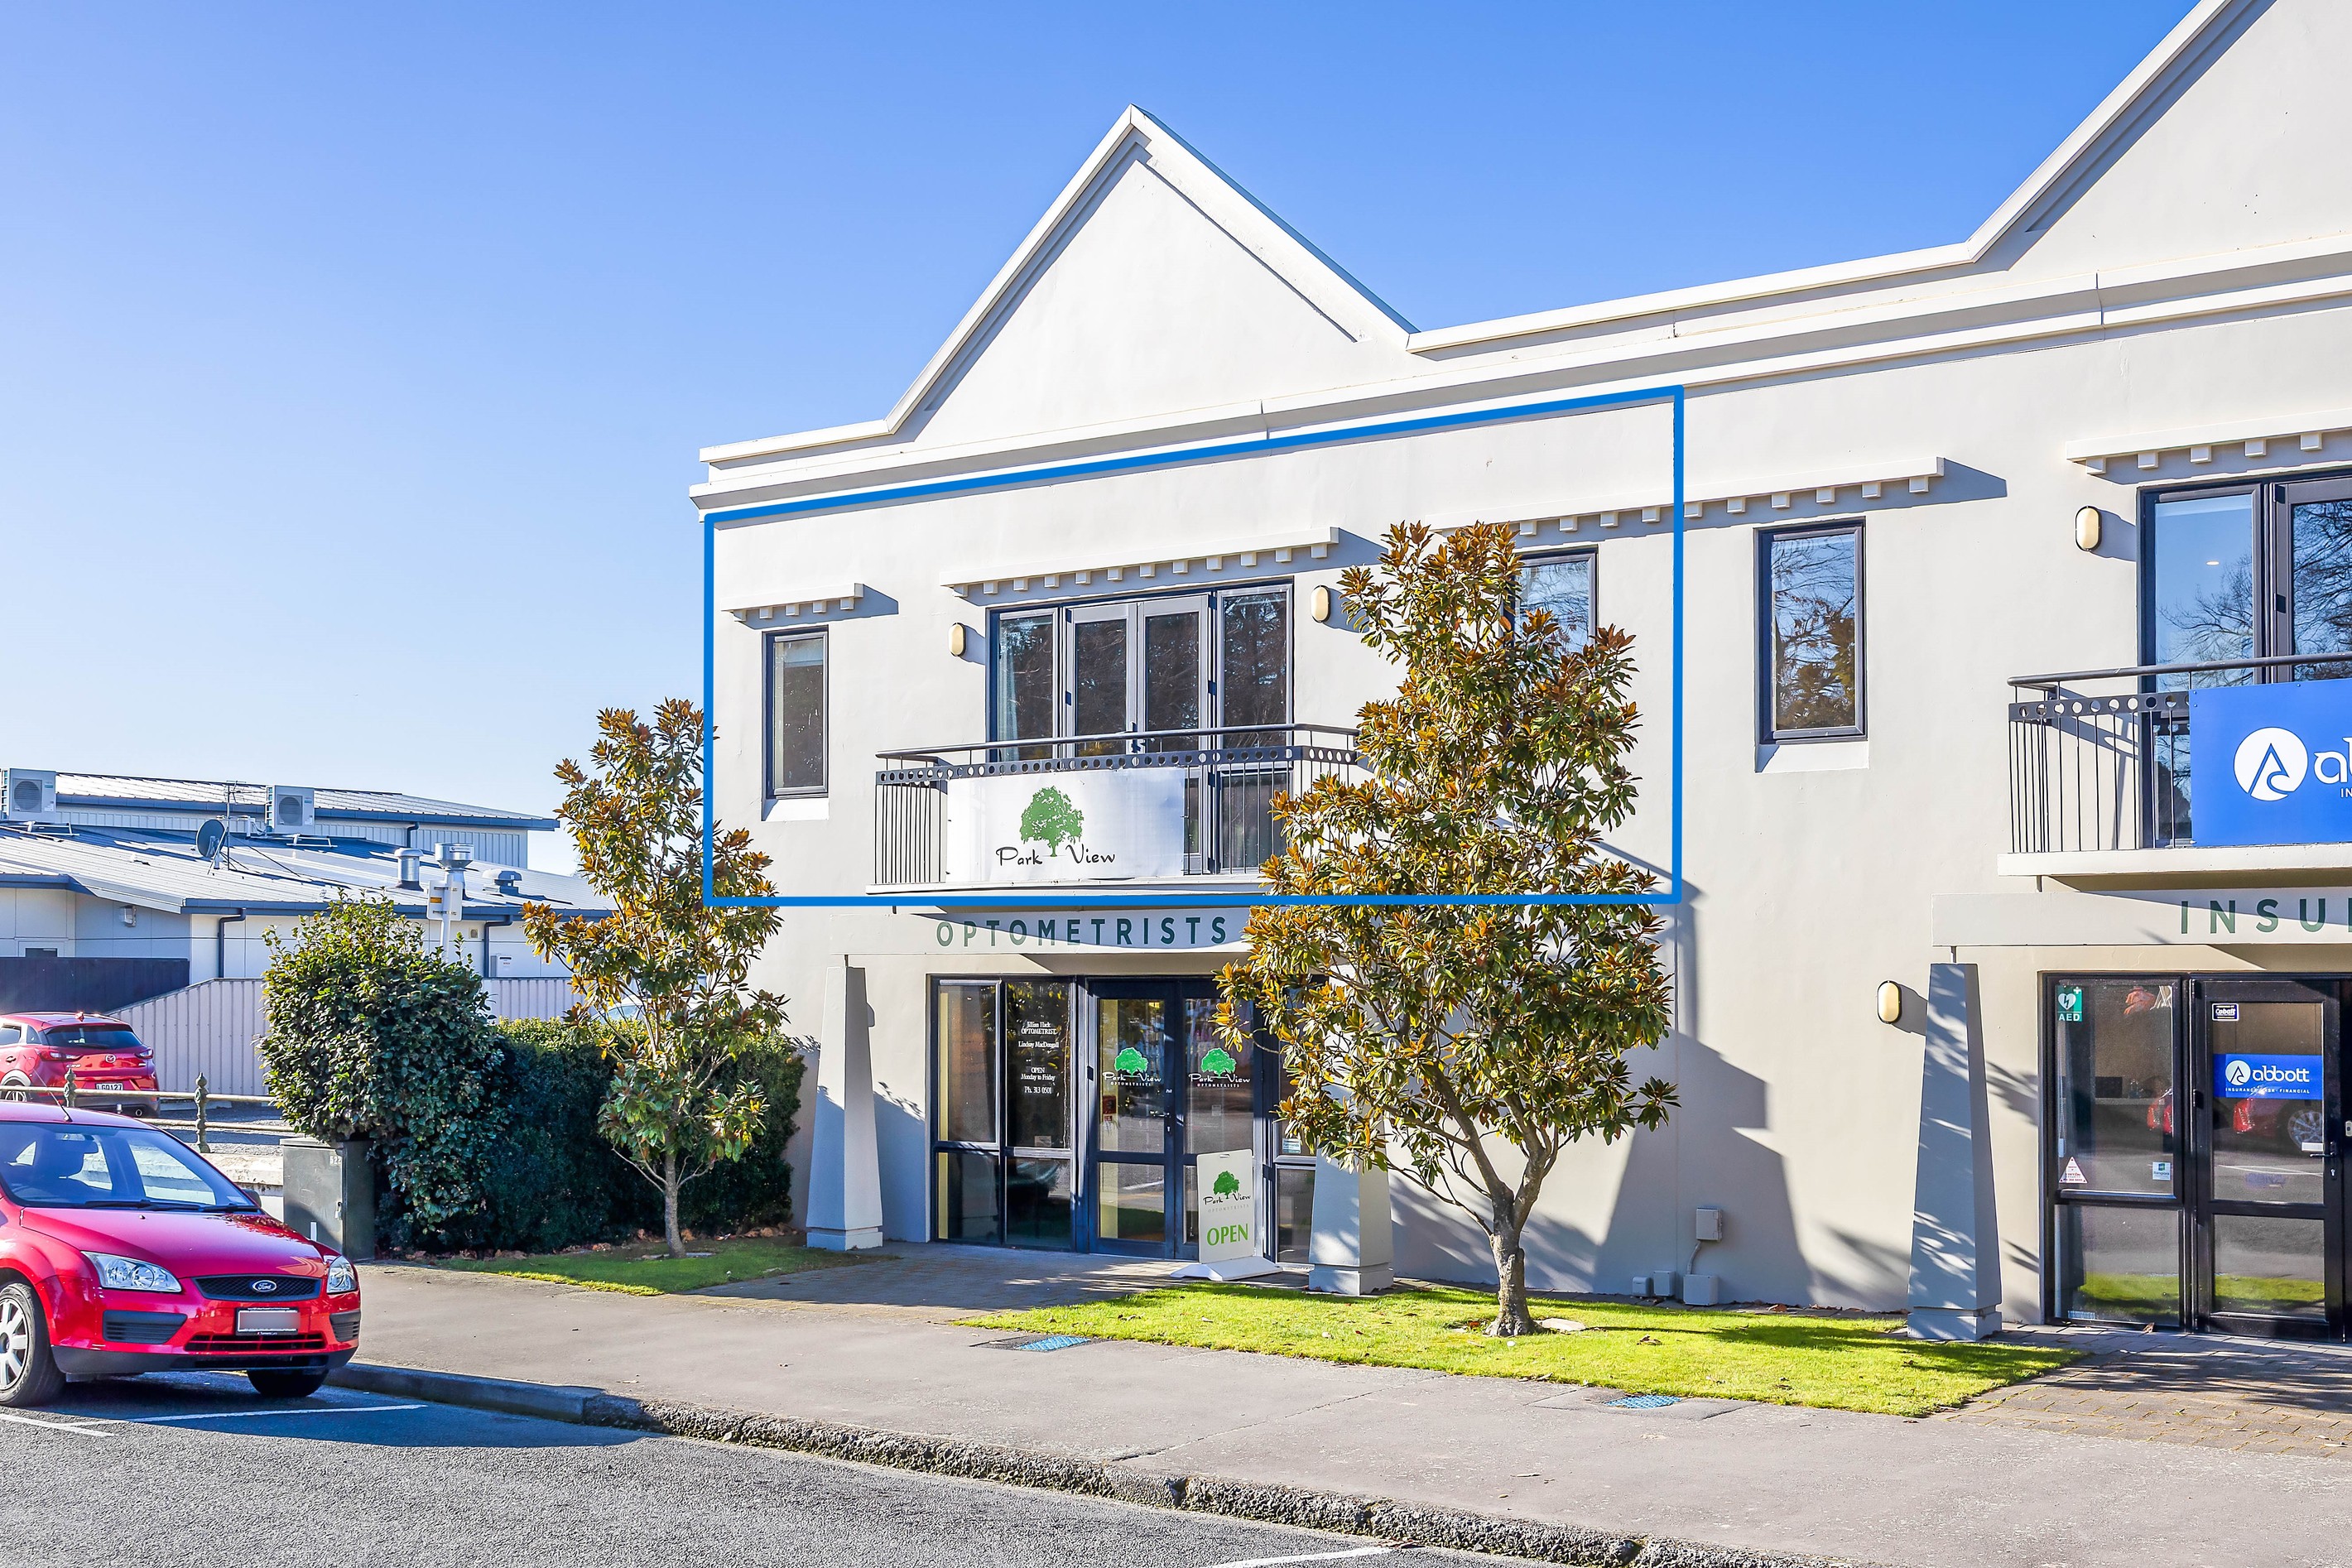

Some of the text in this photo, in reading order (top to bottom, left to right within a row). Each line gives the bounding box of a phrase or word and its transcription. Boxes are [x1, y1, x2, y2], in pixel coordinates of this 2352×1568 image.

[2313, 737, 2352, 784] a
[995, 844, 1116, 866] Park View
[2181, 897, 2352, 934] INSU
[936, 916, 1227, 947] OPTOMETRISTS
[2058, 1013, 2080, 1022] AED
[1102, 1071, 1162, 1082] Park View
[1188, 1073, 1251, 1083] Park View
[2252, 1065, 2310, 1082] abbott
[1203, 1193, 1251, 1205] Park View
[1206, 1223, 1248, 1246] OPEN
